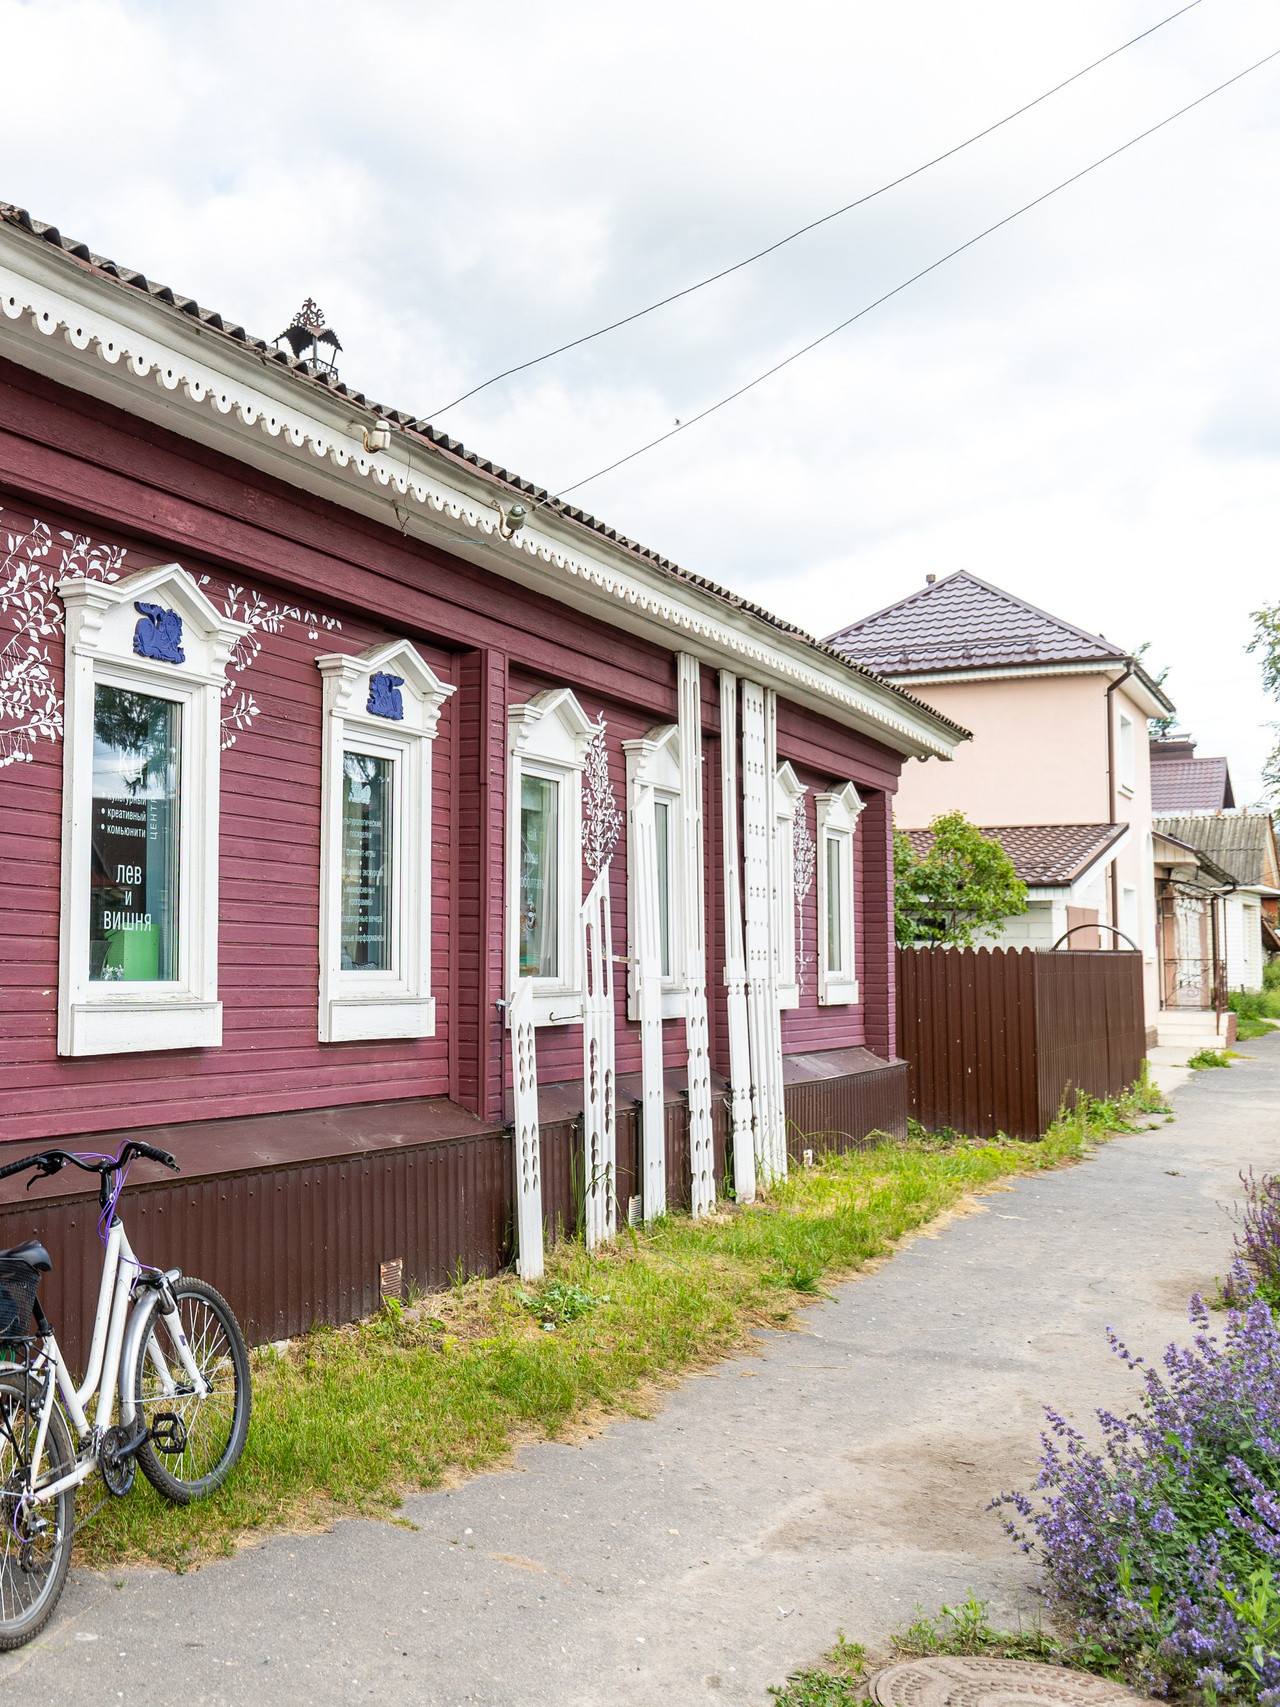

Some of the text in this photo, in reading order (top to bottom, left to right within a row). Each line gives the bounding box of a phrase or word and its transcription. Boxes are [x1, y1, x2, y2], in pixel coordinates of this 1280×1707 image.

[107, 808, 147, 822] креативный
[106, 824, 146, 838] комьюнити
[115, 864, 142, 885] лев
[124, 890, 132, 906] и
[103, 910, 152, 932] вишня
